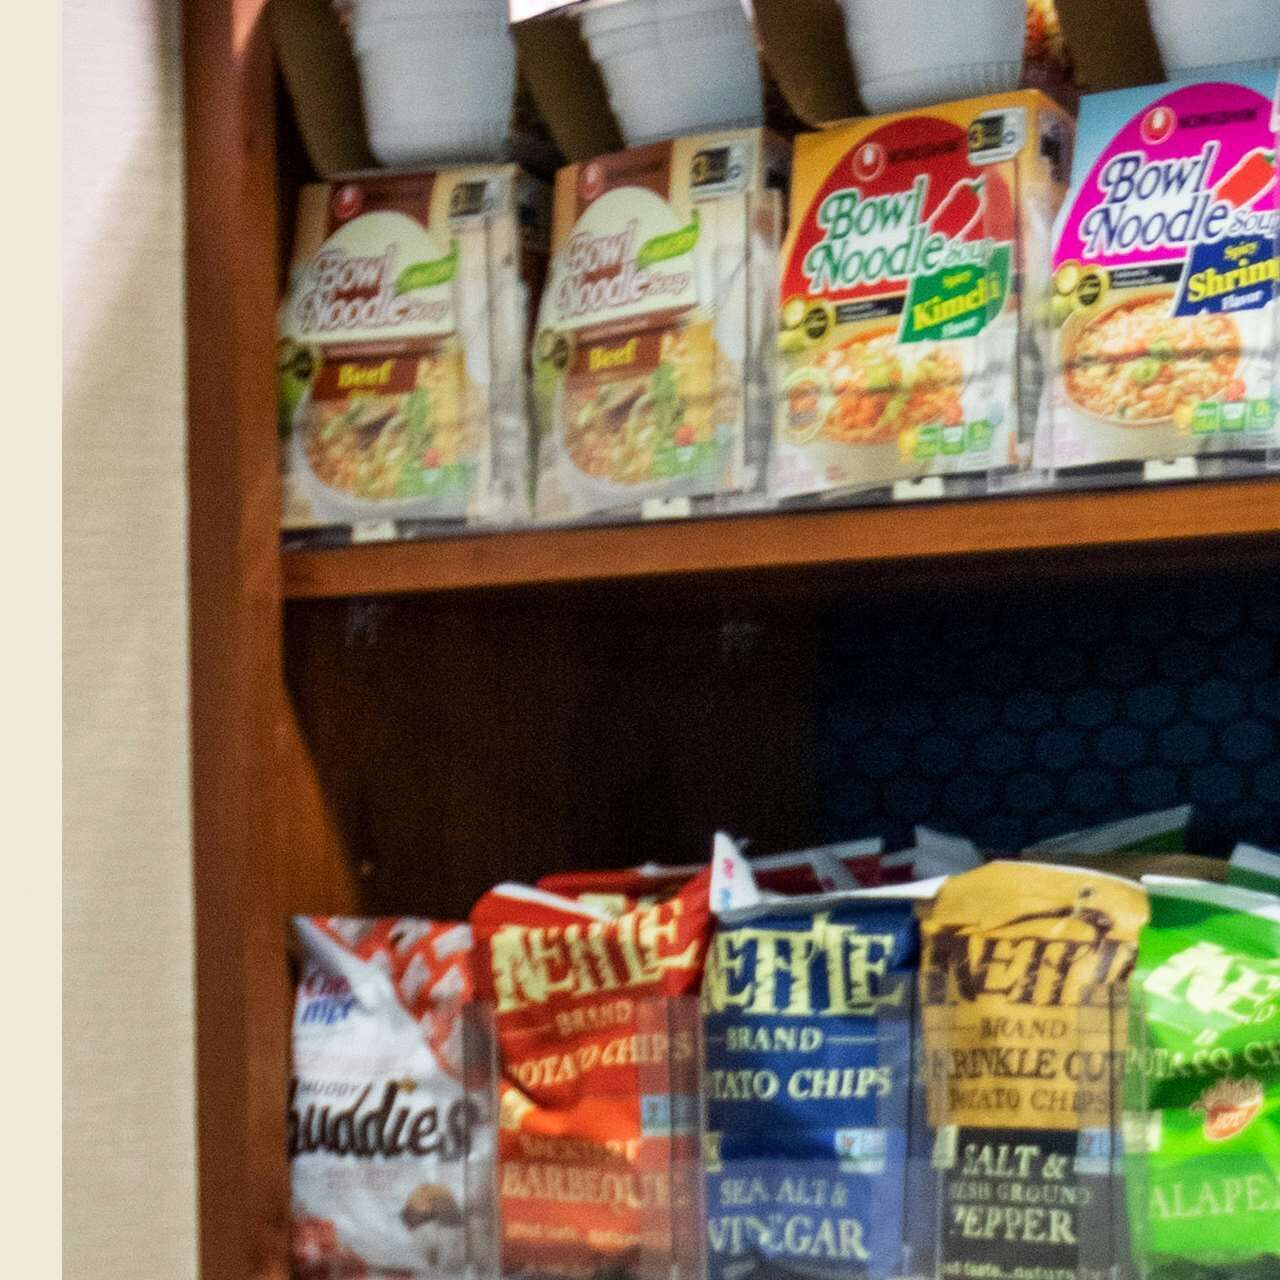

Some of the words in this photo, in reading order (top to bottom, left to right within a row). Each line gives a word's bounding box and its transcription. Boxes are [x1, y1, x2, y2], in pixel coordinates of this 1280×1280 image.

[1101, 142, 1220, 205] Bowl
[818, 174, 929, 241] Bowl
[1083, 195, 1228, 254] Noodle
[805, 224, 947, 291] Noodle
[588, 341, 637, 371] Beef
[335, 360, 396, 390] Beef
[726, 1026, 823, 1052] BRAND
[981, 1018, 1067, 1040] BRAND
[602, 1032, 694, 1066] CHIPS
[787, 1066, 893, 1098] CHIPS
[962, 1144, 1042, 1178] SALT
[1042, 1152, 1067, 1178] &
[708, 1216, 871, 1259] VINEGAR
